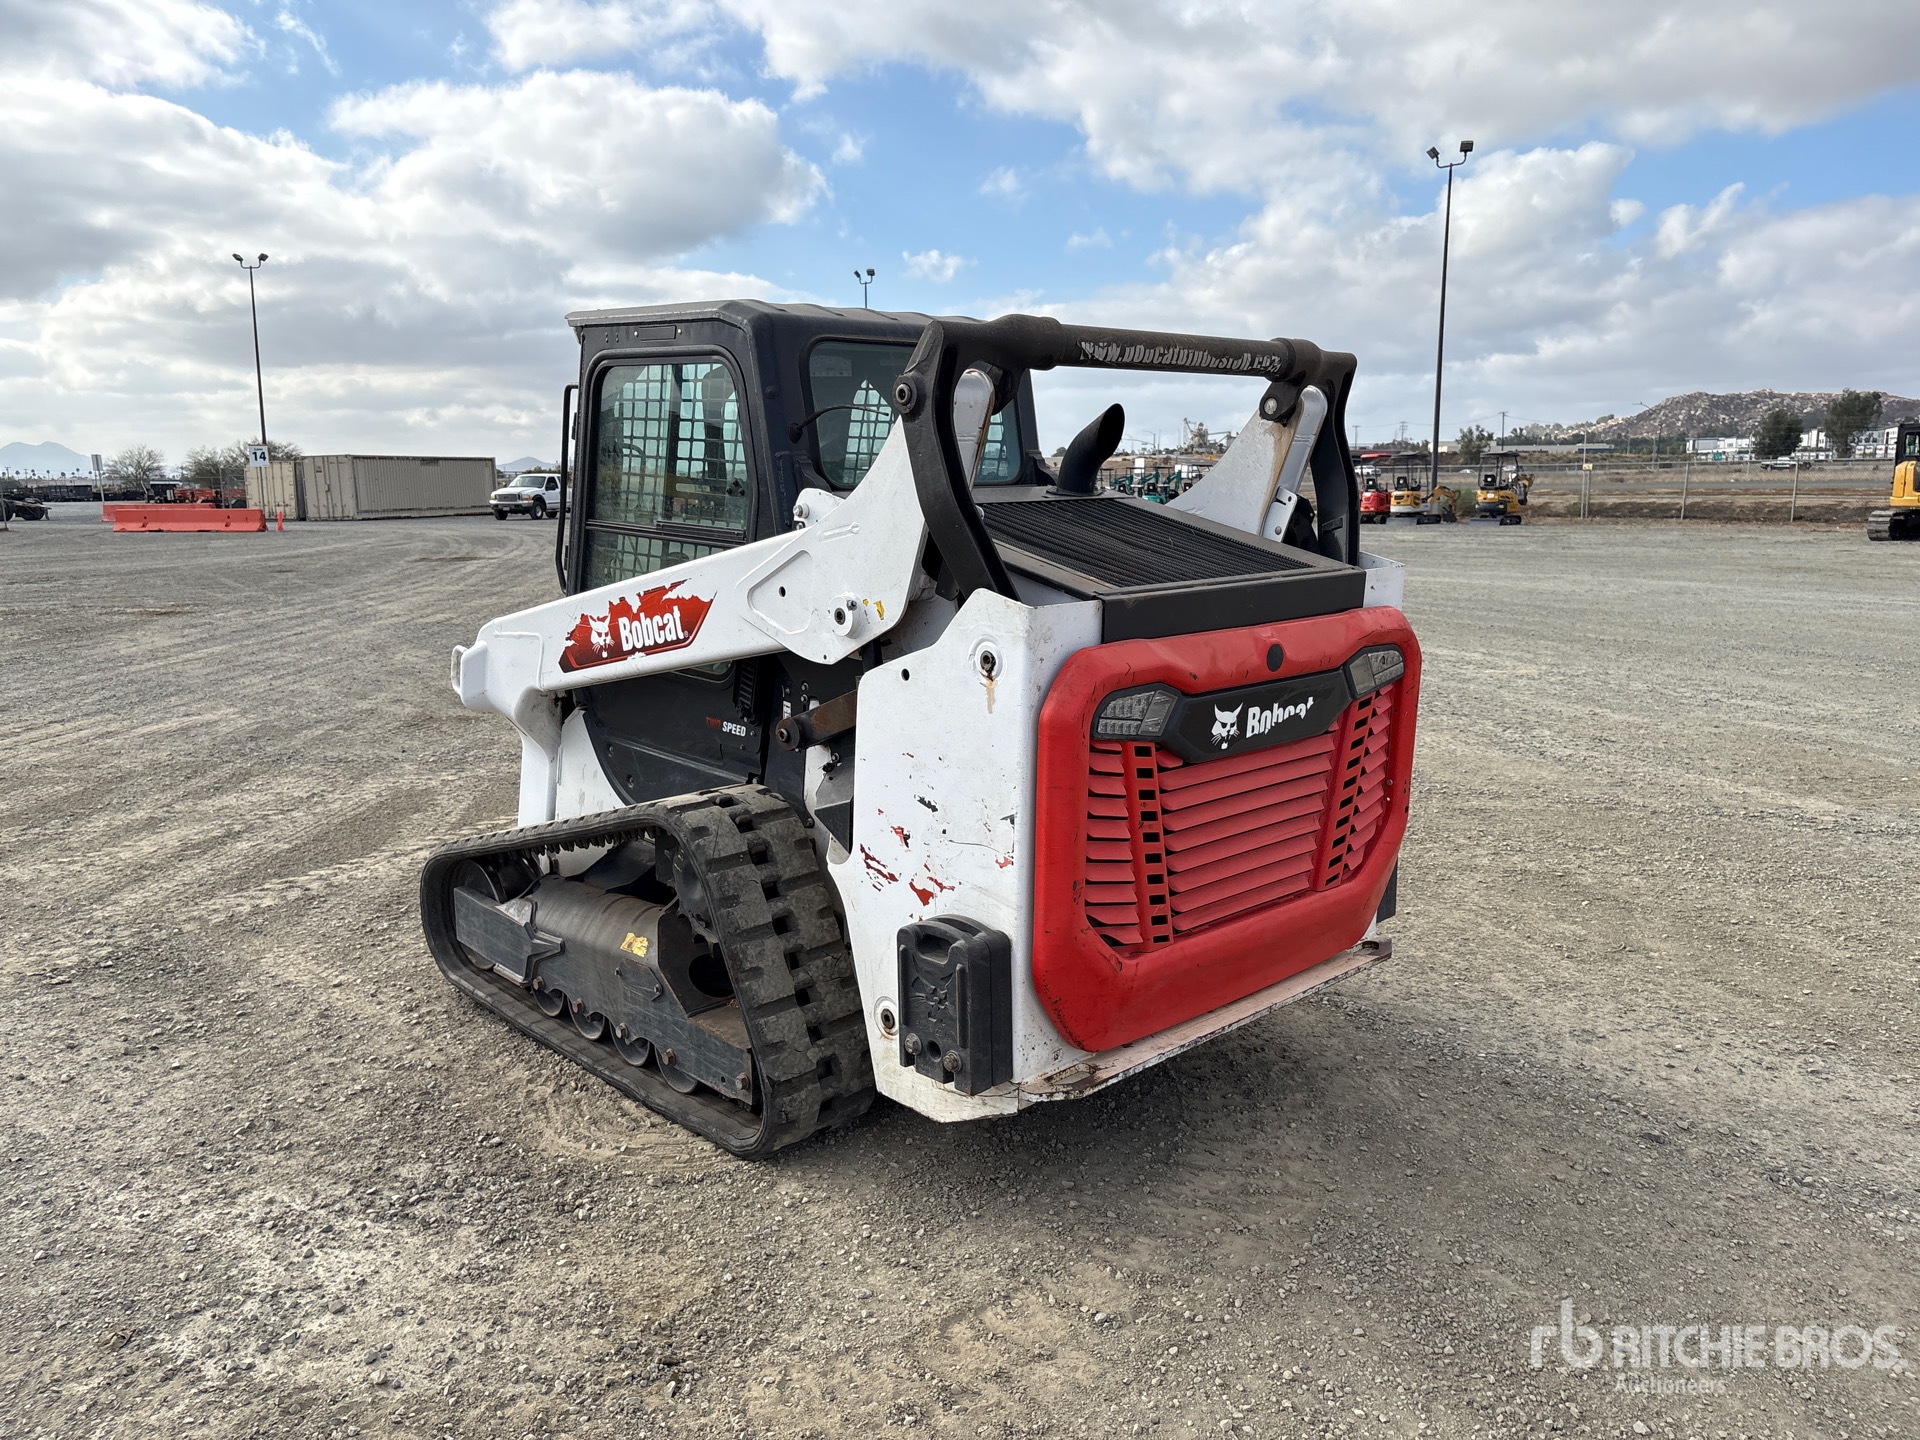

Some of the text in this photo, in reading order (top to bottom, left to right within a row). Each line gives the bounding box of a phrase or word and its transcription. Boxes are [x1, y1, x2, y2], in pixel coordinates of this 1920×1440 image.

[252, 451, 266, 461] 14
[618, 605, 684, 652] Bobcat
[722, 721, 747, 737] SPEED
